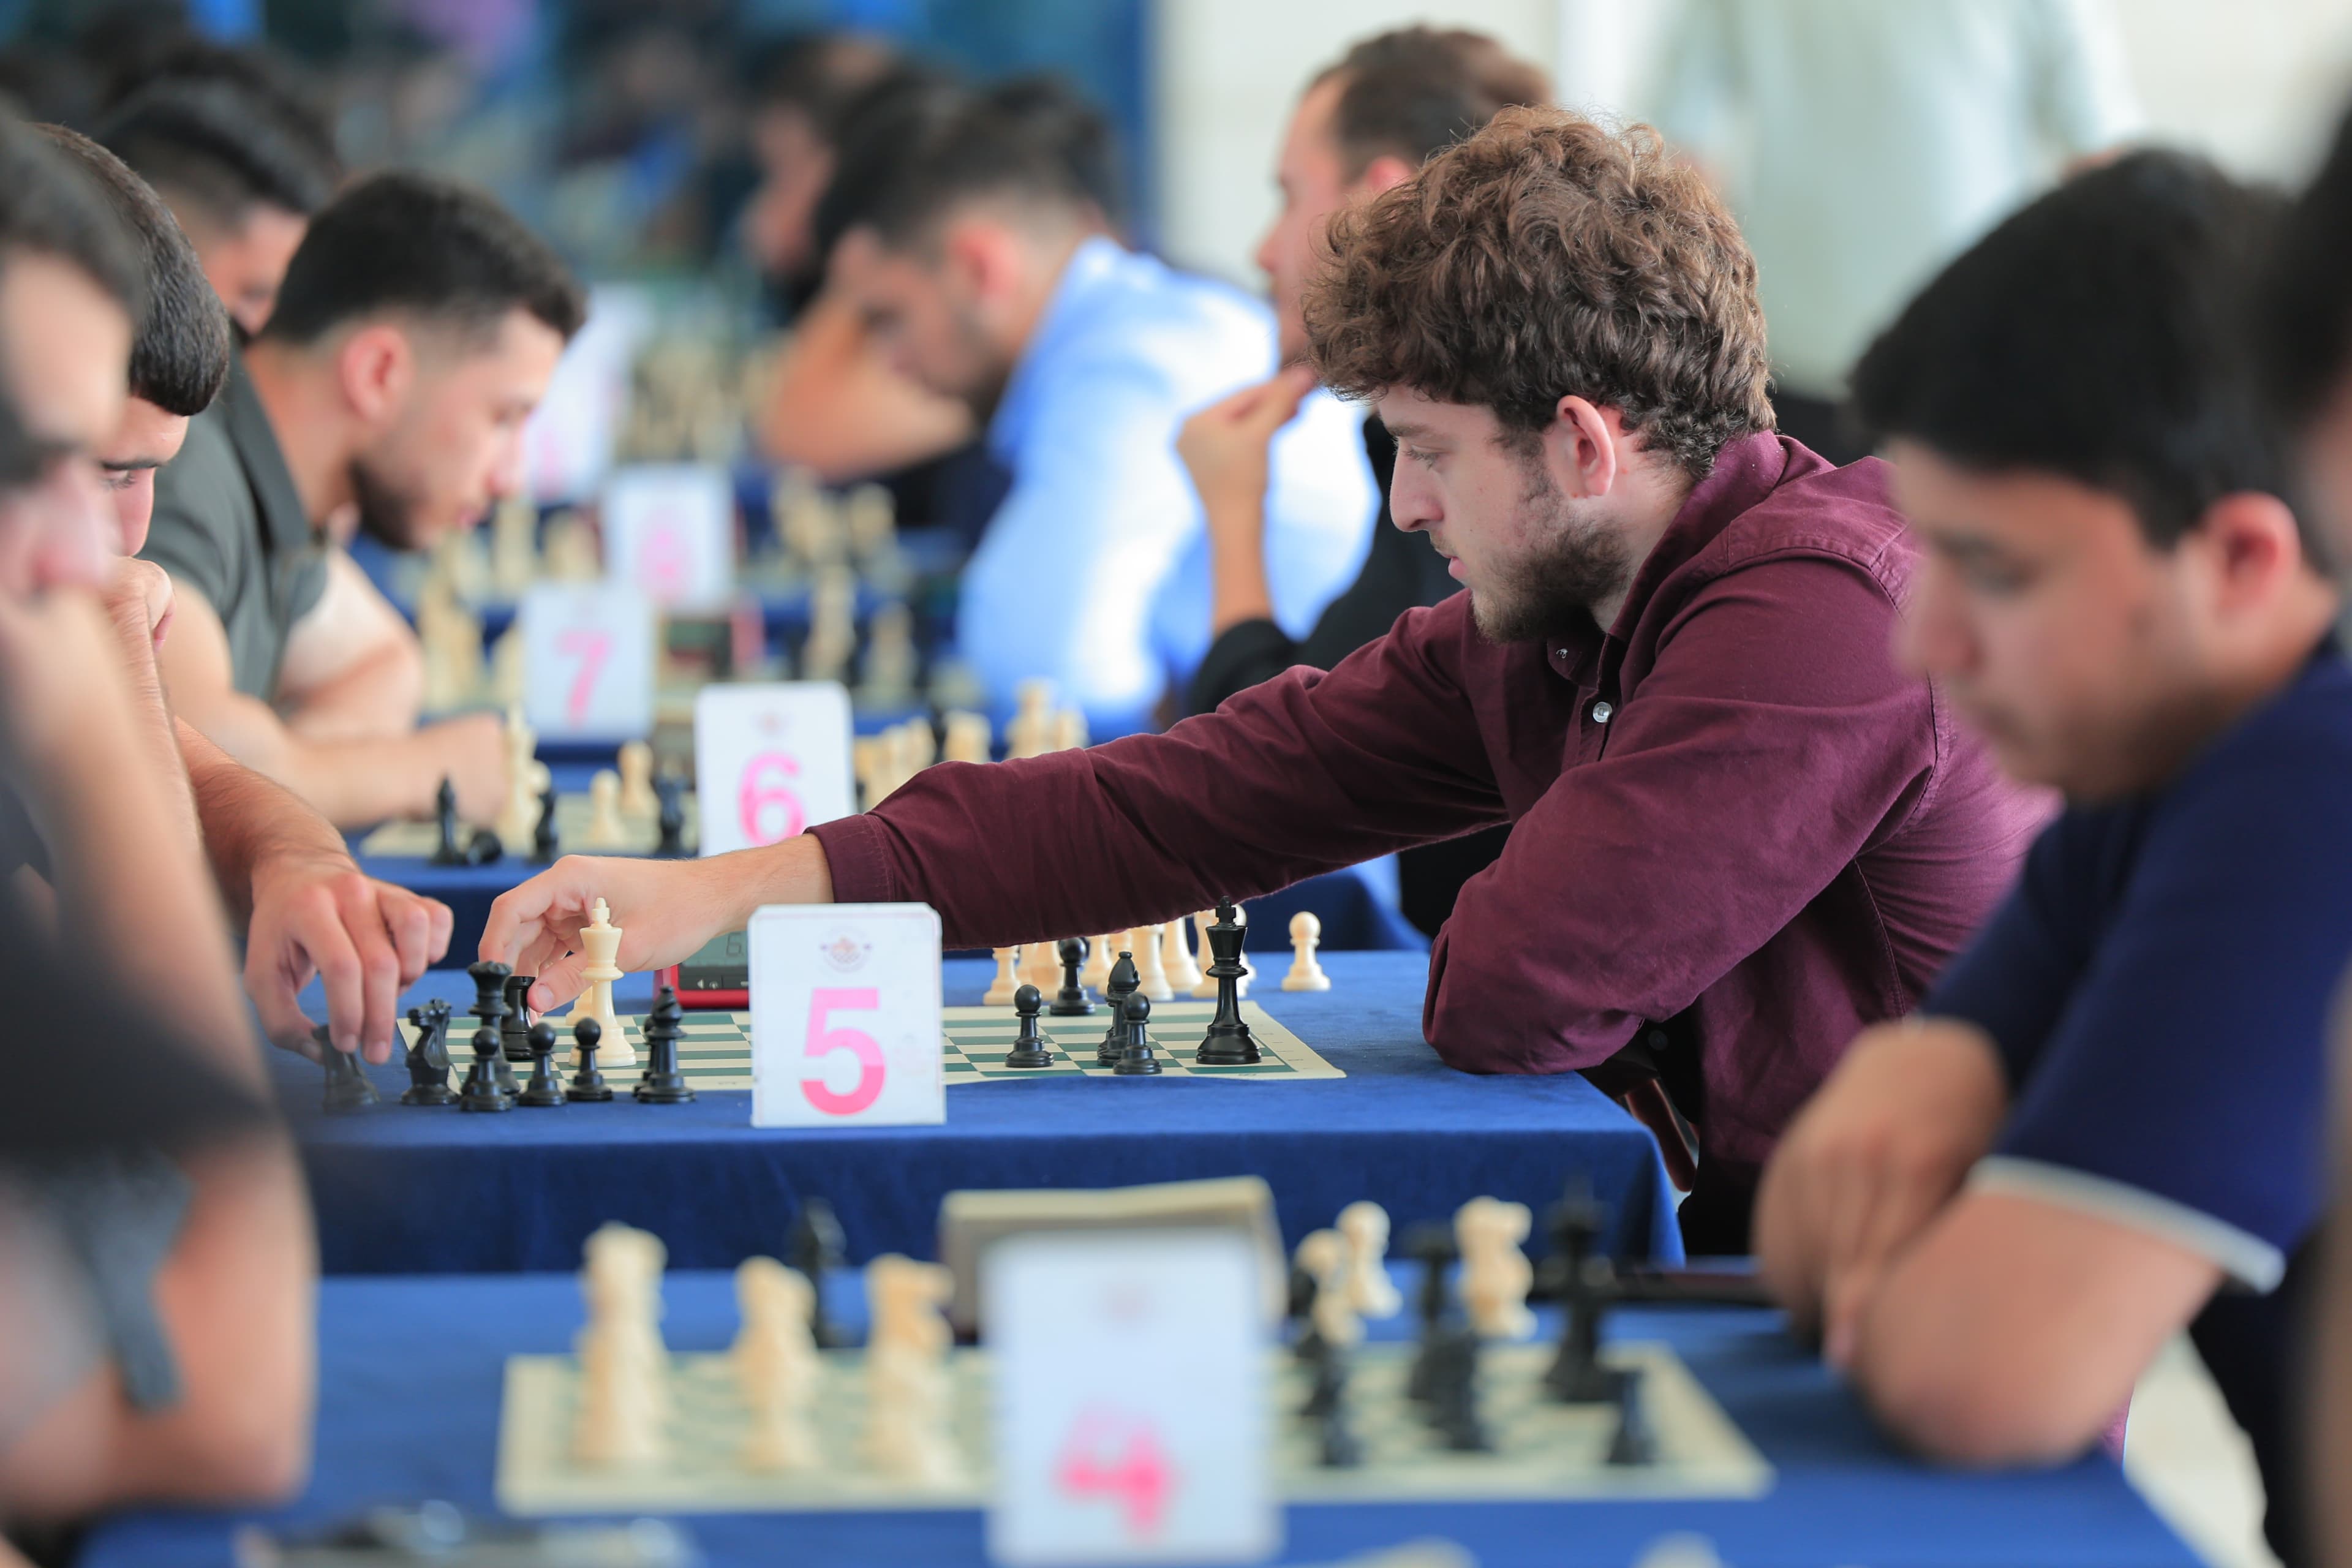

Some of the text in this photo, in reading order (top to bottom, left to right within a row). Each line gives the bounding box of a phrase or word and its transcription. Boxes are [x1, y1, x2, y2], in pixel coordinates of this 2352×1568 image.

[554, 627, 613, 729] 7
[737, 750, 807, 846] 6
[799, 987, 886, 1117] 5
[1049, 1401, 1183, 1545] 4
